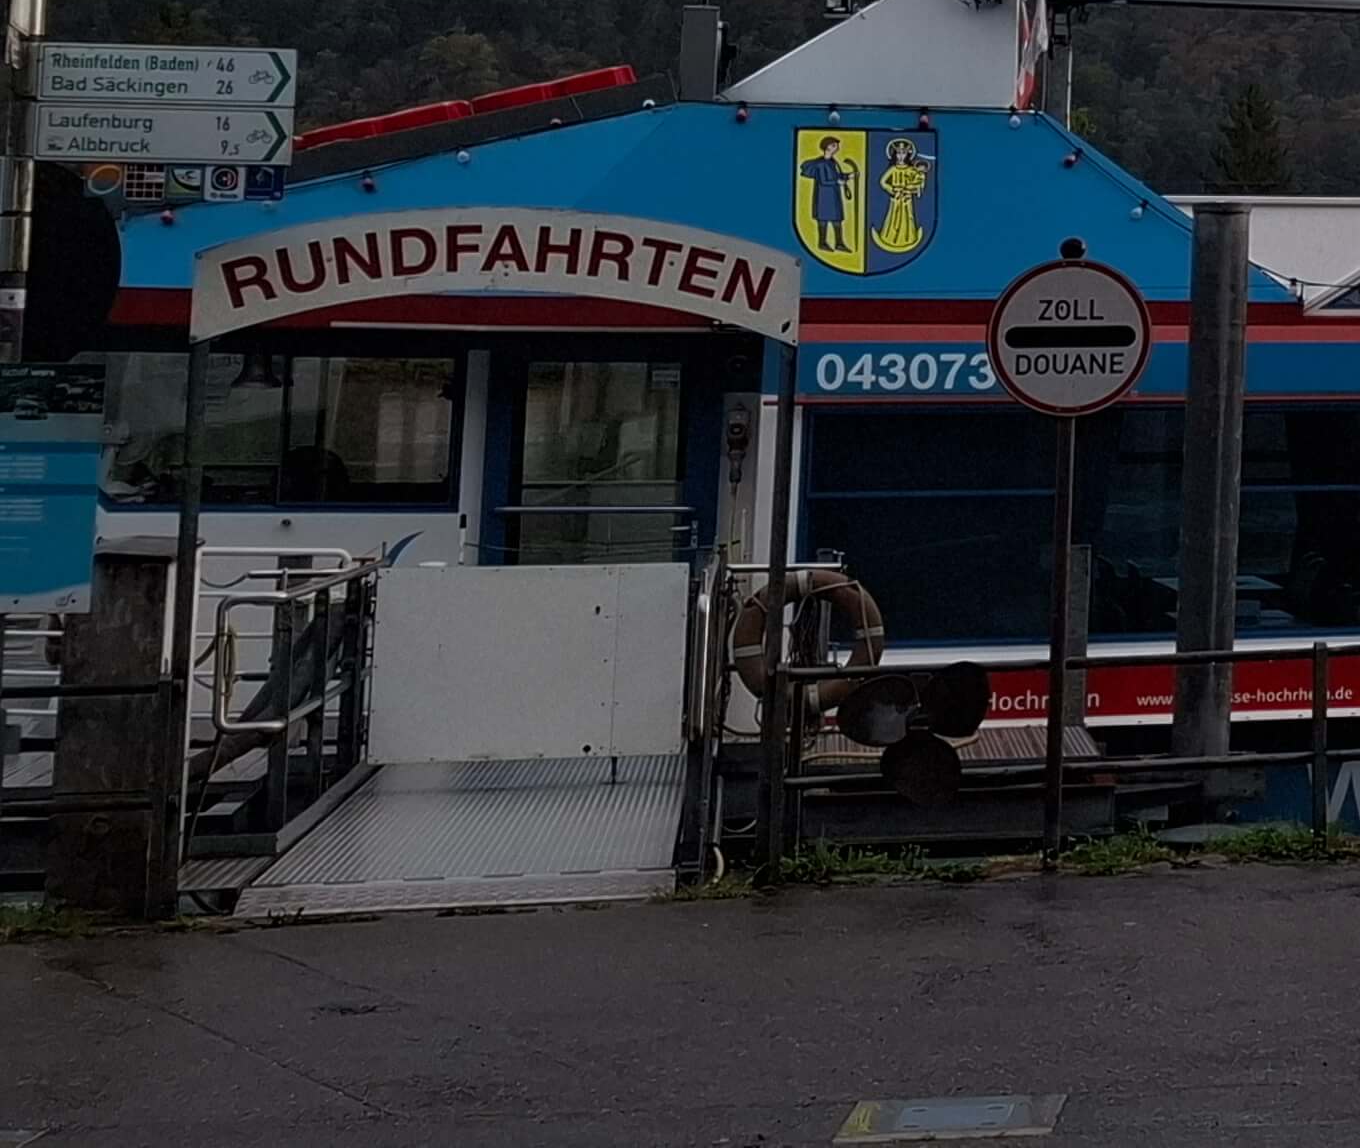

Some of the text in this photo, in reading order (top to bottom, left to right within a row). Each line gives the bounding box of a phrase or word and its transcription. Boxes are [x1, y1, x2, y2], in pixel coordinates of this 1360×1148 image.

[51, 53, 235, 73] Rheinfelden (Baden) 46
[51, 75, 233, 96] Bad Säckingen 26
[48, 112, 231, 133] Laufenburg 16
[67, 137, 151, 153] Albbruck
[221, 224, 775, 312] RUNDFAHRTEN
[1038, 299, 1105, 321] ZOLL
[1014, 353, 1125, 376] DOUANE
